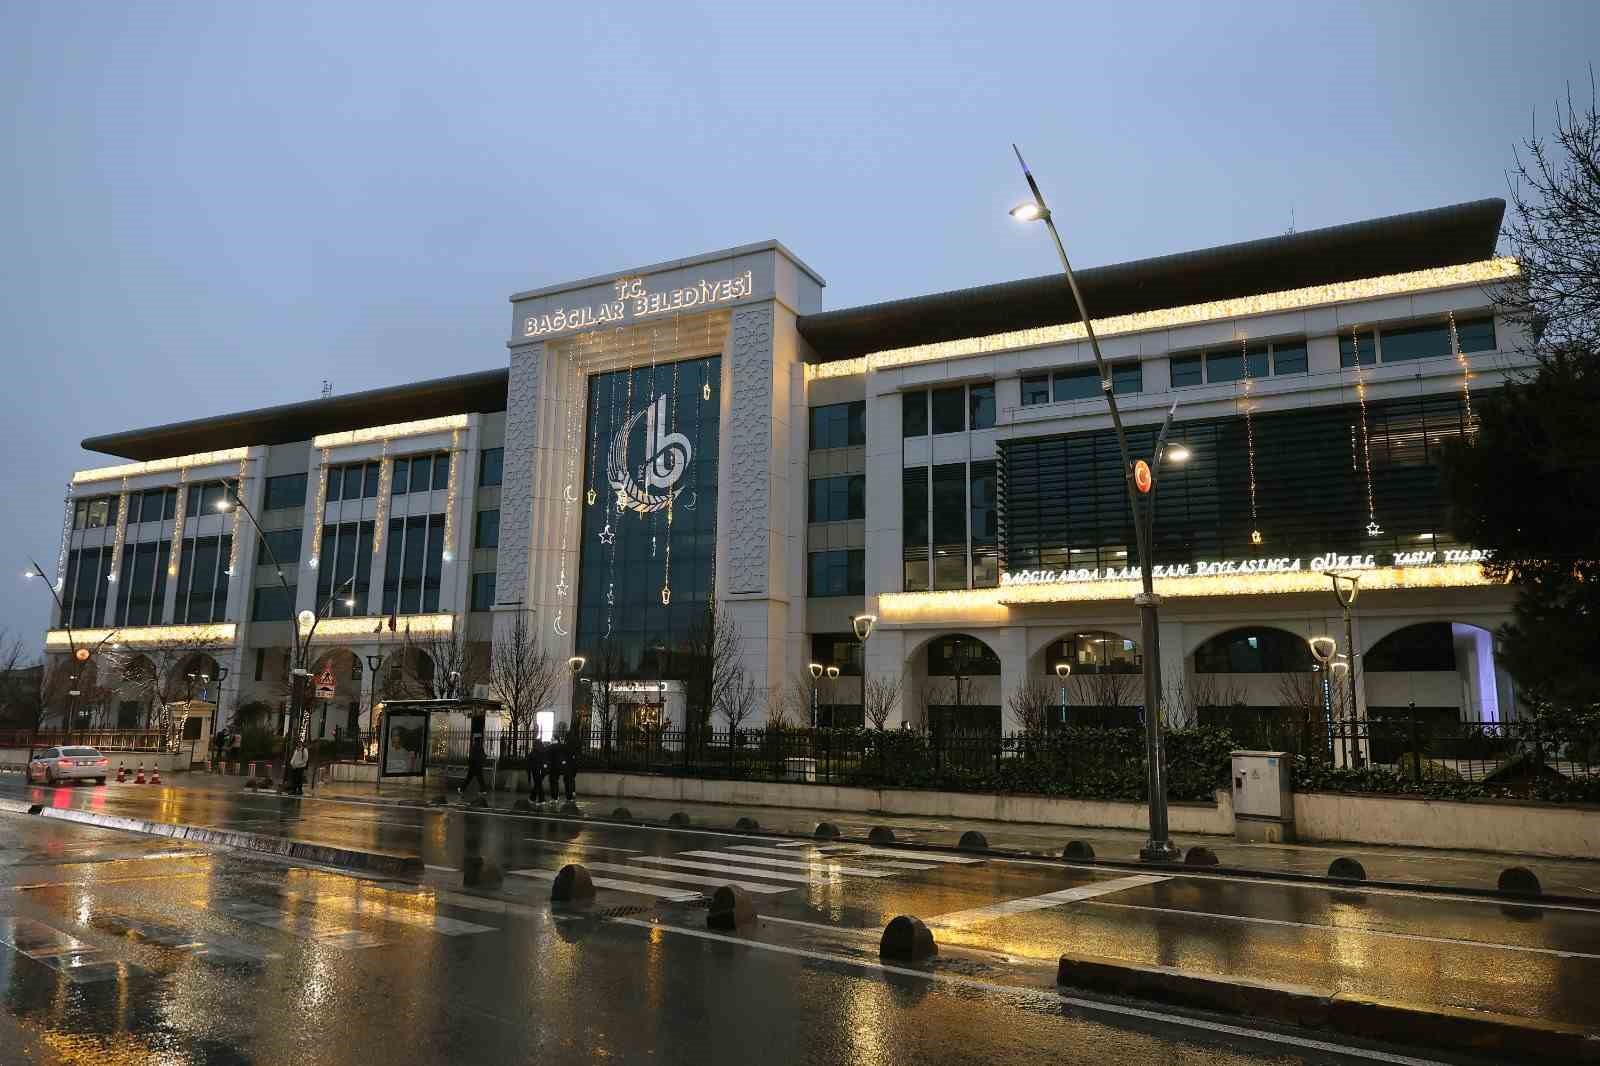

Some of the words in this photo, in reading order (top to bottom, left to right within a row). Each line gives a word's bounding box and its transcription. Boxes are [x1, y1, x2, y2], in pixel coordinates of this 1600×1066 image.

[616, 279, 646, 301] T.C.
[525, 302, 625, 337] BAĞCILAR
[632, 270, 753, 317] BELEDİYESİ
[1106, 564, 1190, 579] RAMZAN
